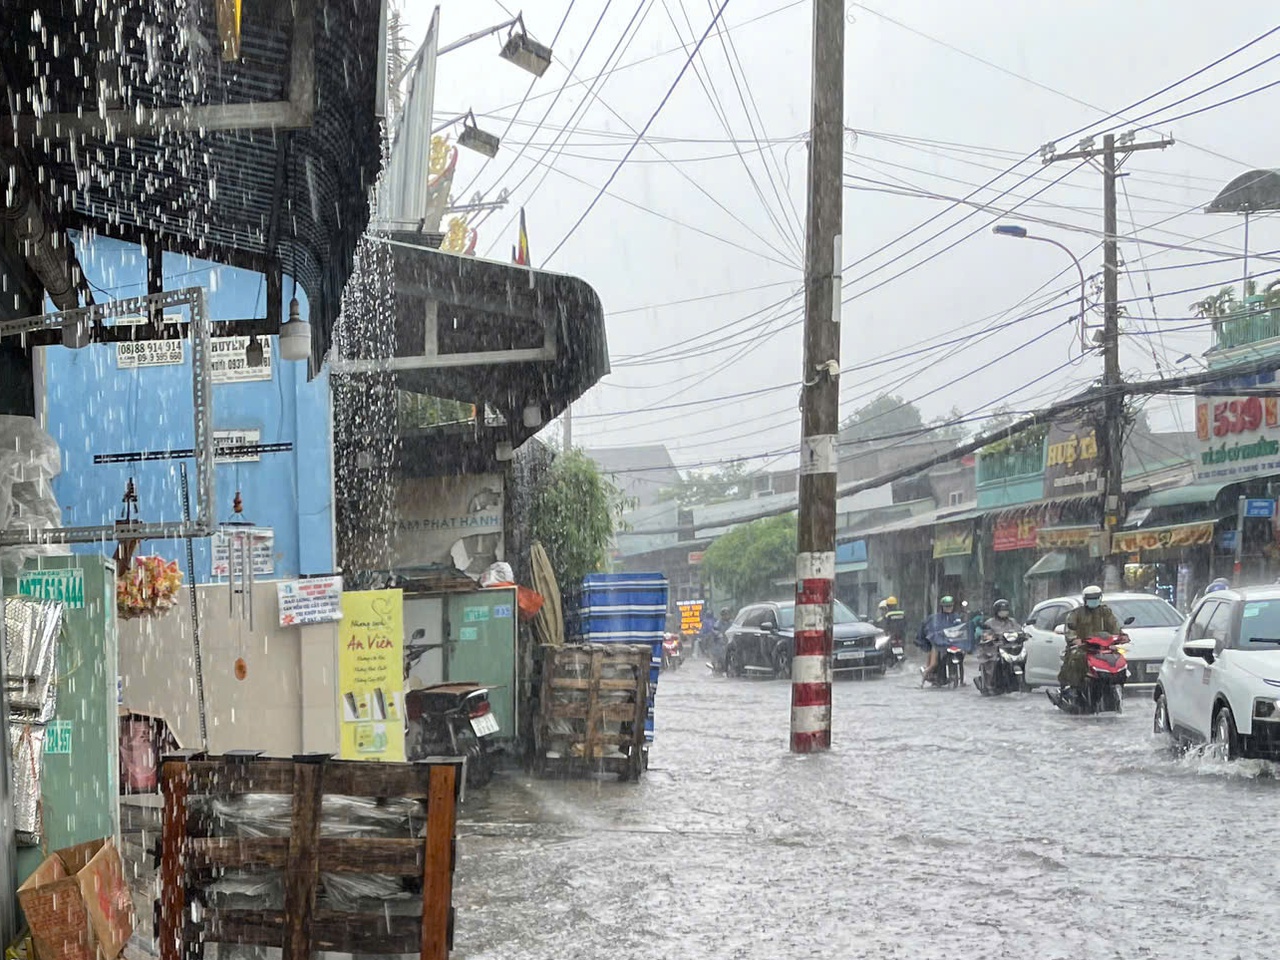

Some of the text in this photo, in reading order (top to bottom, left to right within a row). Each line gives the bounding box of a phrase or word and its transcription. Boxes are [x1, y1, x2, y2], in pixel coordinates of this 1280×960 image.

[147, 342, 164, 353] 914
[165, 341, 182, 352] 914
[137, 354, 155, 362] 099
[1213, 396, 1263, 437] 539
[64, 576, 84, 608] 444
[347, 634, 365, 651] An
